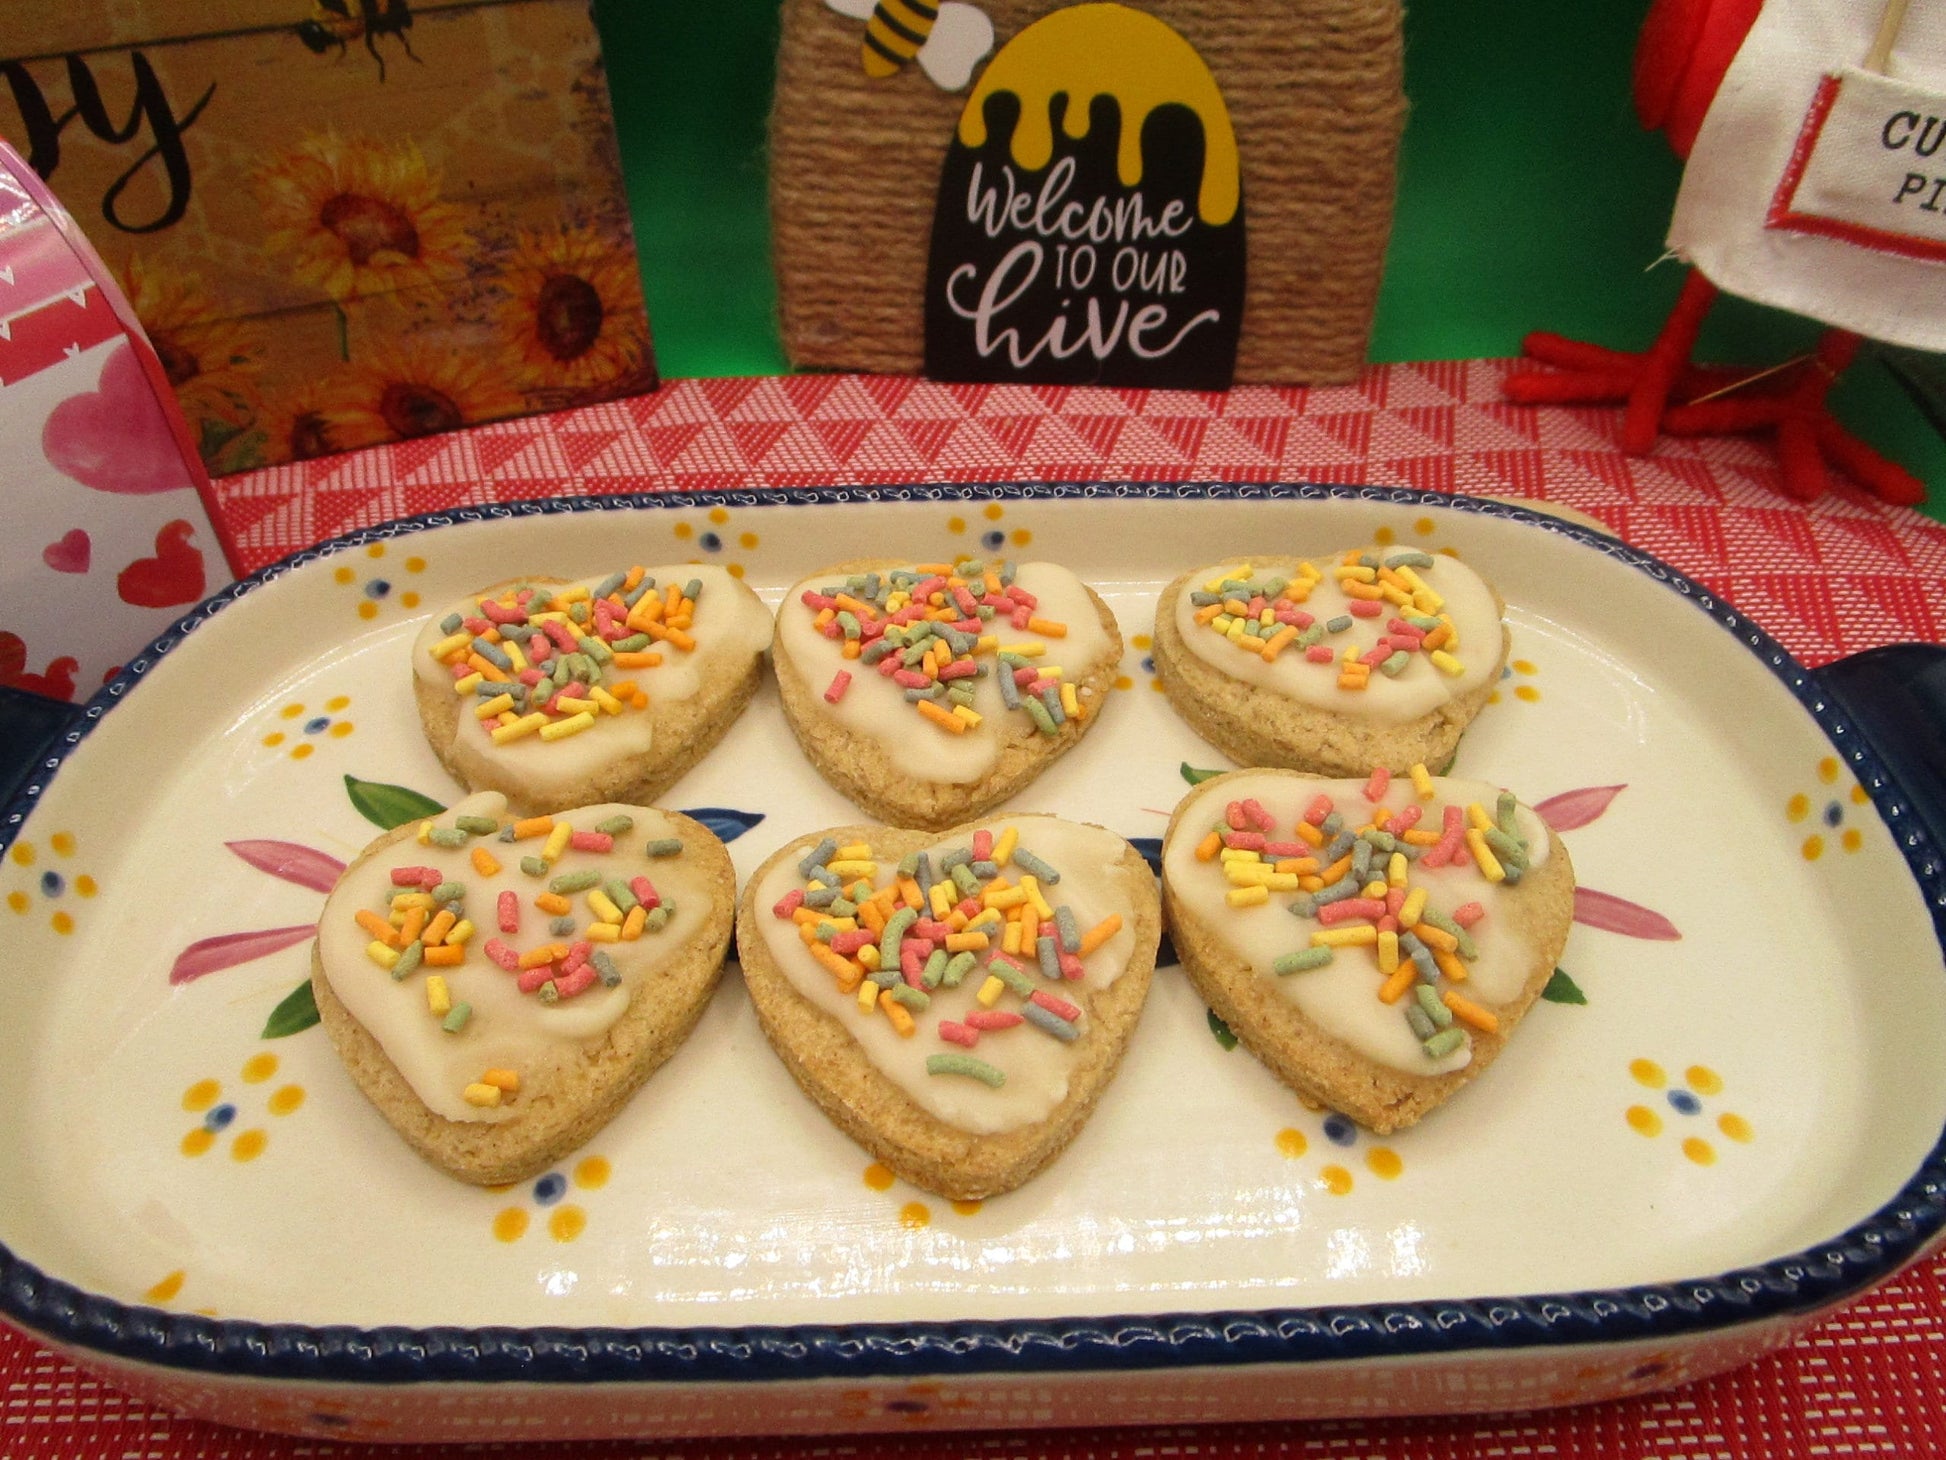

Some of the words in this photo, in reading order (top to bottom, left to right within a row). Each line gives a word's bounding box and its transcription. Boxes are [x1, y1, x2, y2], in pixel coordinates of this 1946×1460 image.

[967, 156, 1194, 243] Welcome
[1892, 172, 1946, 214] PI
[1055, 244, 1097, 290] TO
[1112, 246, 1188, 295] OUR
[946, 240, 1220, 369] hive
